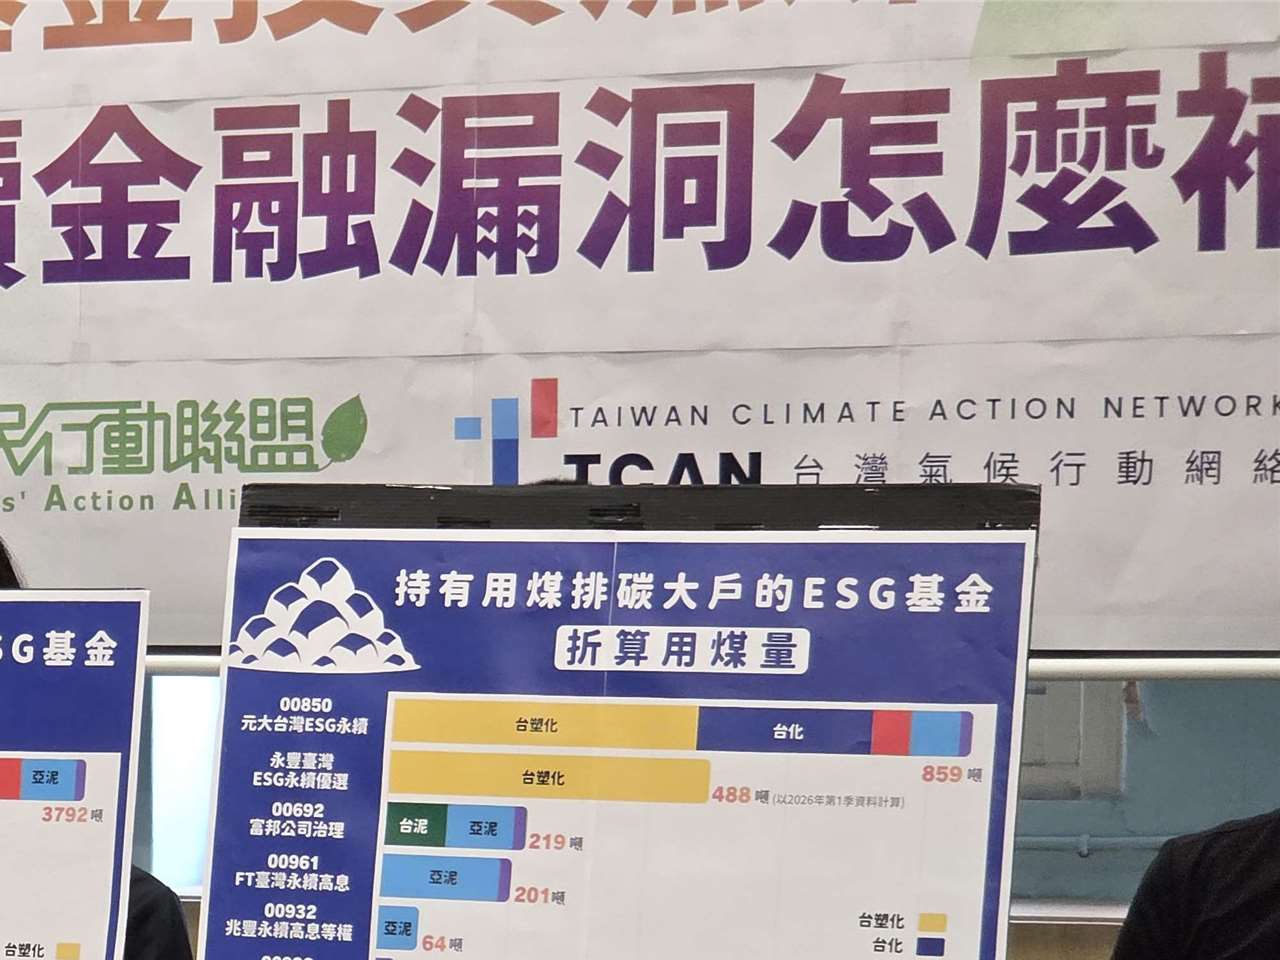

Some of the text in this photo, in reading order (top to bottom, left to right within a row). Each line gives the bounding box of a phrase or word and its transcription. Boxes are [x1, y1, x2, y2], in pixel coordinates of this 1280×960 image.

[570, 404, 709, 428] TAIWAN
[731, 401, 907, 426] CLIMATE
[928, 397, 1077, 421] ACTION
[563, 452, 762, 485] TCAN
[794, 449, 1280, 487] 台灣氣候行動網絡
[44, 484, 154, 511] Action
[172, 482, 236, 511] Alli
[394, 569, 994, 614] 持有用煤排碳大戶的ESG基金
[566, 629, 798, 670] 折算用煤量
[280, 697, 332, 712] 00850
[241, 715, 368, 735] 元大台灣ESG永續
[515, 717, 558, 733] 台塑化
[772, 723, 804, 740] 台化
[270, 752, 334, 770] 永豐臺灣
[32, 769, 59, 785] 亞泥
[252, 771, 349, 790] ESG永續優選
[522, 769, 565, 786] 台塑化
[921, 765, 963, 782] 859
[711, 786, 751, 803] 488
[42, 806, 88, 822] 3792
[271, 802, 324, 818] 00692
[249, 819, 344, 839] 富邦公司治理
[399, 818, 428, 835] 台泥
[469, 820, 498, 836] 亞泥
[528, 832, 566, 850] 219
[267, 854, 319, 870] 00961
[235, 871, 350, 892] FT臺灣永續高息
[428, 869, 458, 886] 亞泥
[514, 886, 550, 904] 201
[264, 903, 317, 919] 00932
[384, 920, 412, 937] 亞泥
[858, 912, 905, 930] 台塑化
[225, 919, 353, 941] 兆豐永續高息等權
[4, 942, 45, 958] 台塑化
[422, 935, 447, 952] 64
[872, 937, 904, 954] 台化
